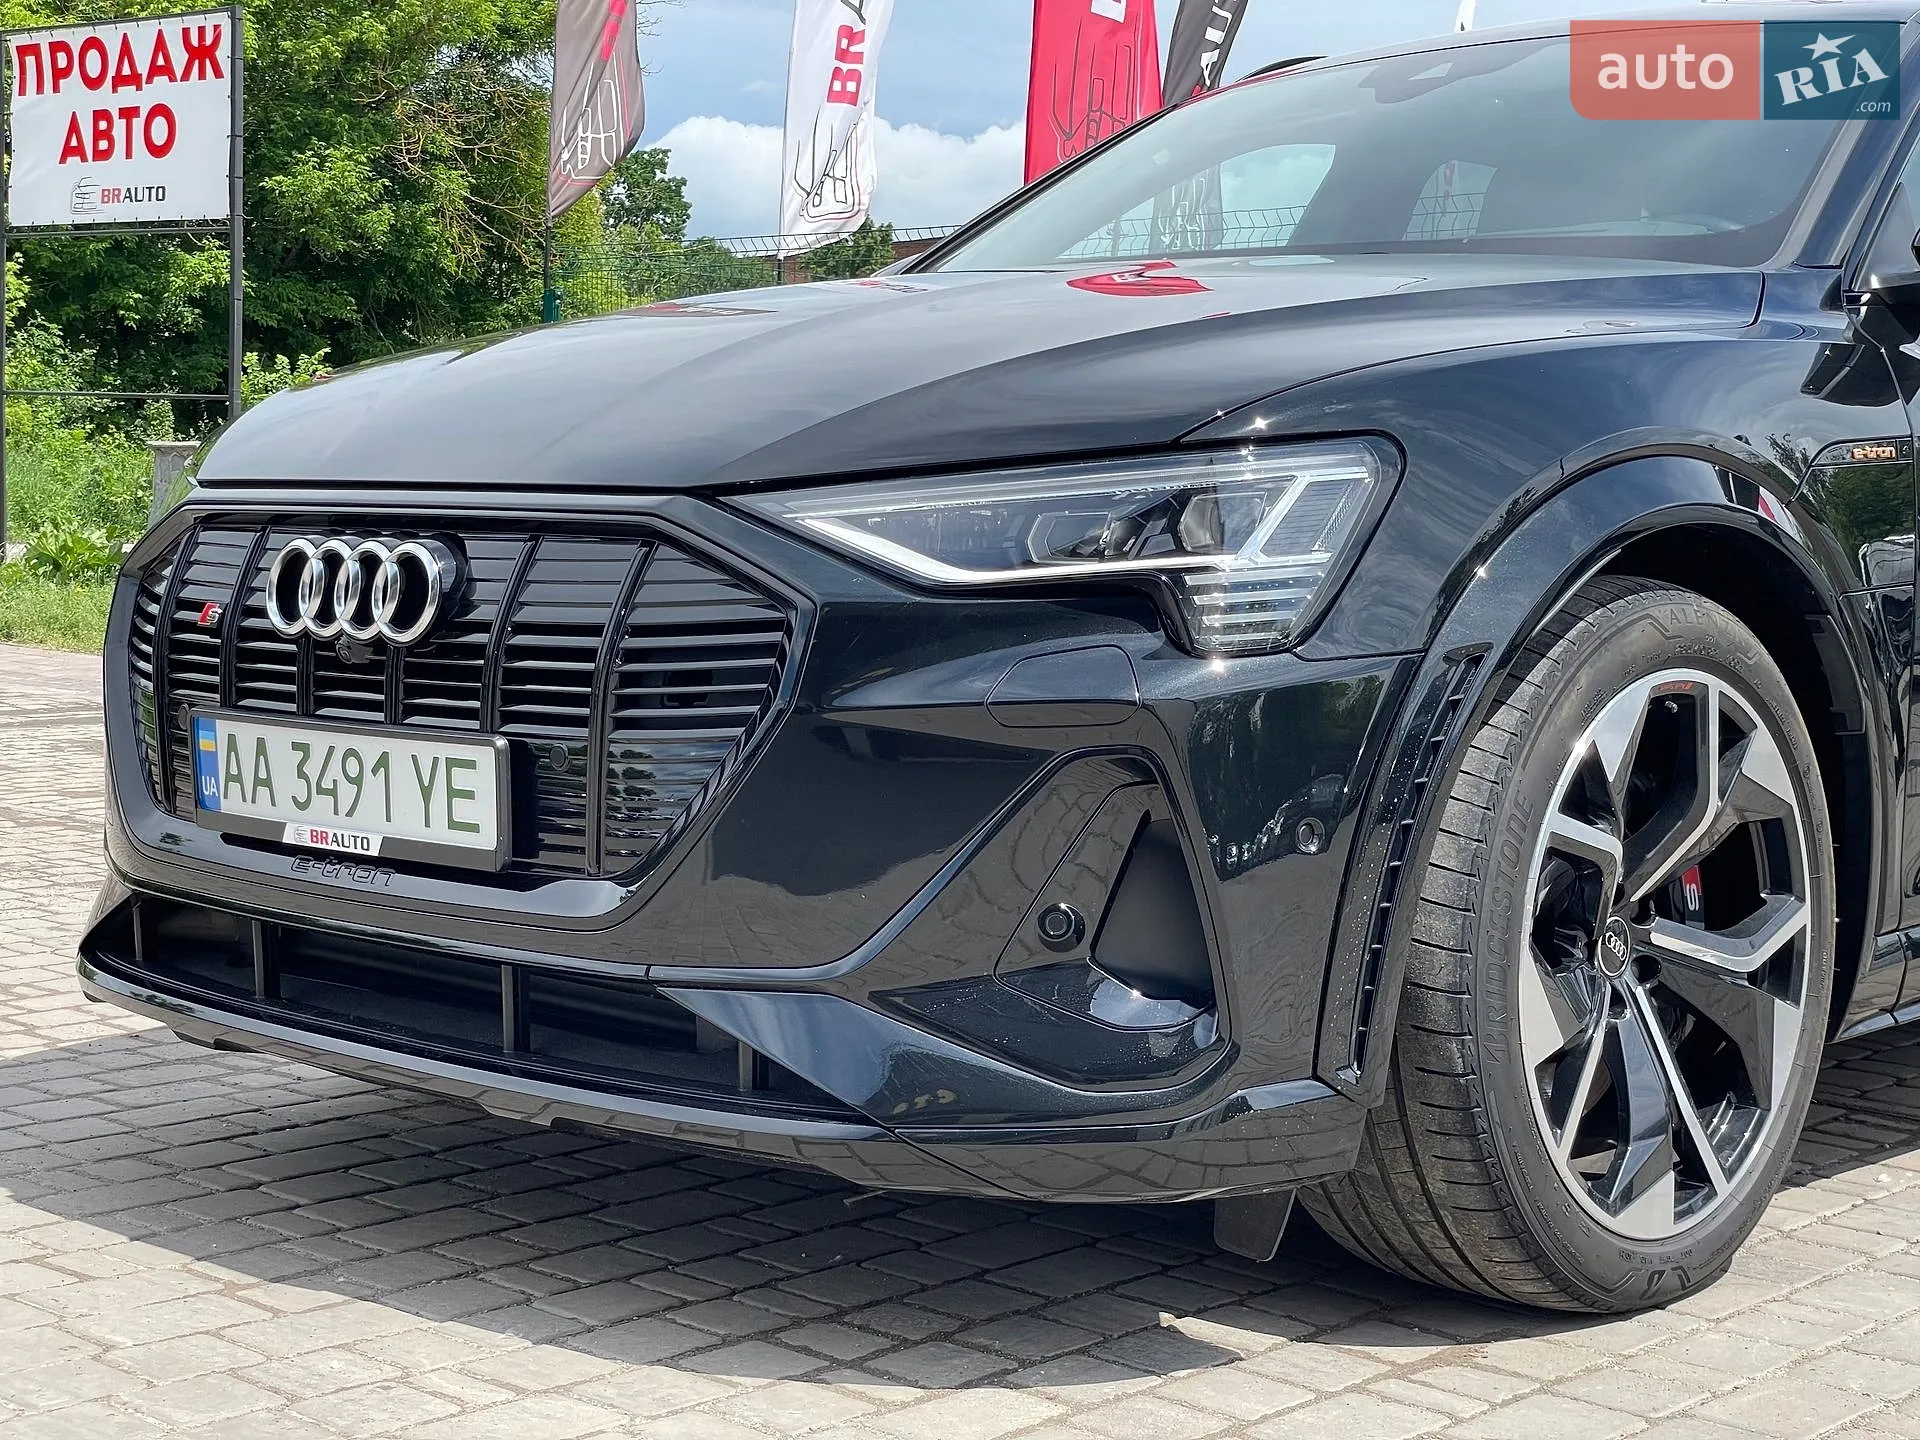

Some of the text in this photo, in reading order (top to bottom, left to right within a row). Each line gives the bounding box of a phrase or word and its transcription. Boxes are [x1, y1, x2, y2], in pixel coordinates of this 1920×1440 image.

[16, 24, 225, 96] ПРОДАЖ
[58, 103, 176, 164] АВТО
[100, 185, 166, 204] BRAUTO
[1851, 445, 1896, 460] e-tron
[201, 775, 218, 797] UA
[223, 733, 480, 834] AA 3491 YE
[309, 828, 371, 852] BRAUTO
[291, 855, 396, 887] e-tron
[1483, 790, 1534, 1065] BRIDGESTONE
